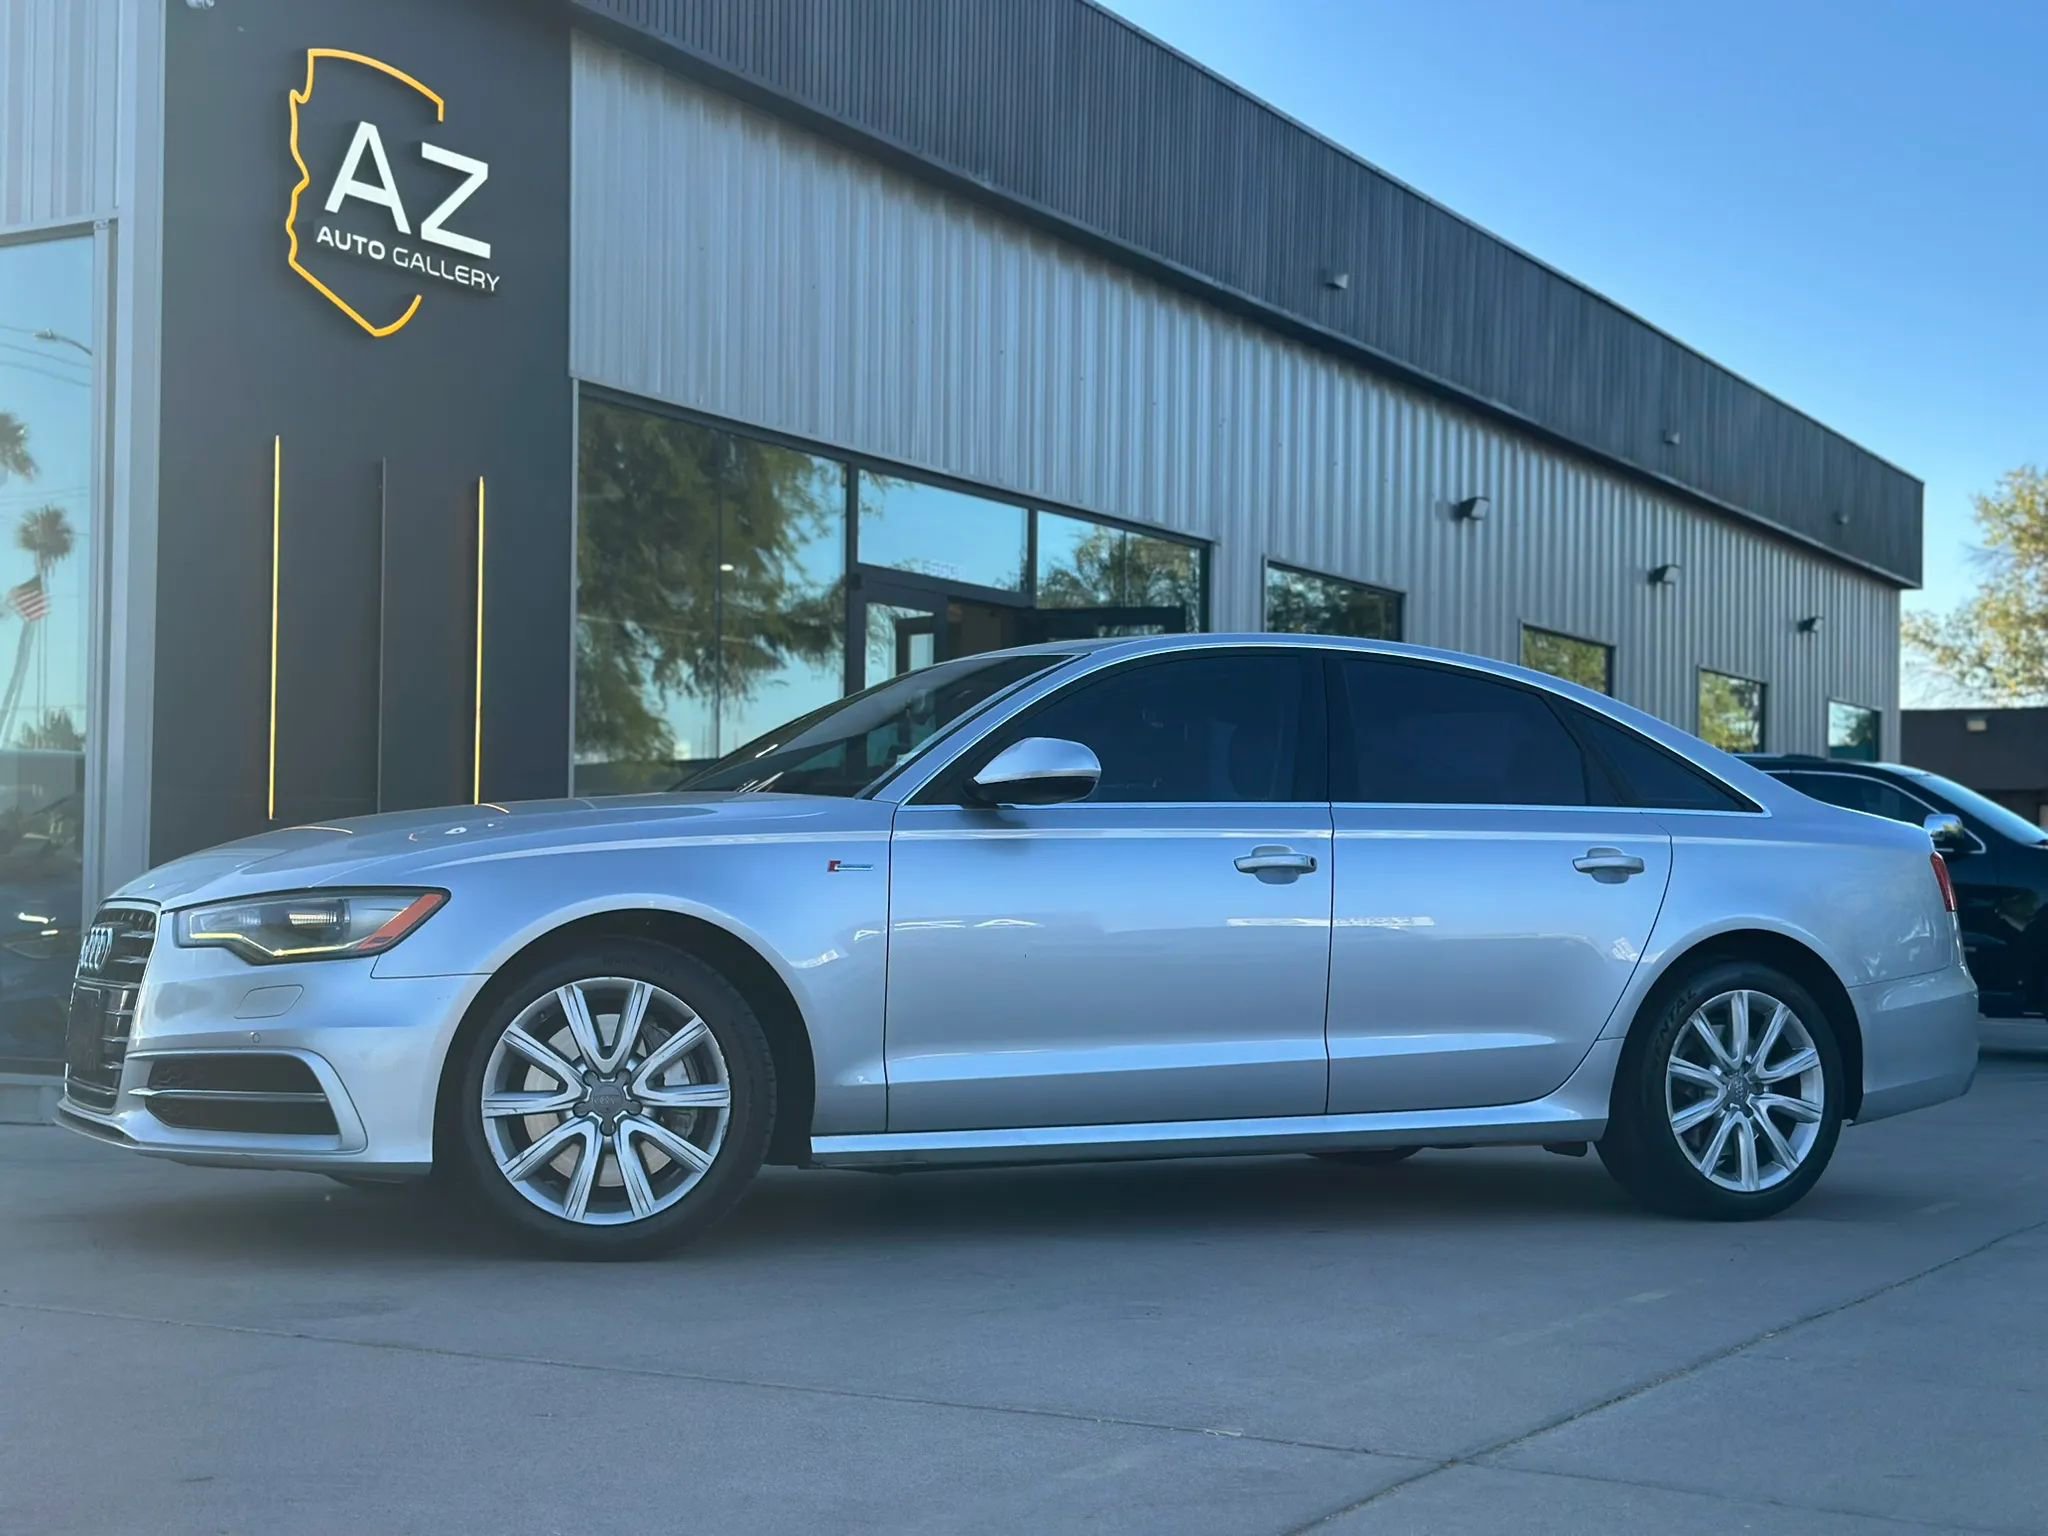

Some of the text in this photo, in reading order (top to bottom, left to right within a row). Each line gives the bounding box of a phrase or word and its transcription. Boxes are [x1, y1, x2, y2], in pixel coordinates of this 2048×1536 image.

[324, 120, 492, 260] AZ
[316, 225, 501, 292] AUTO GALLERY
